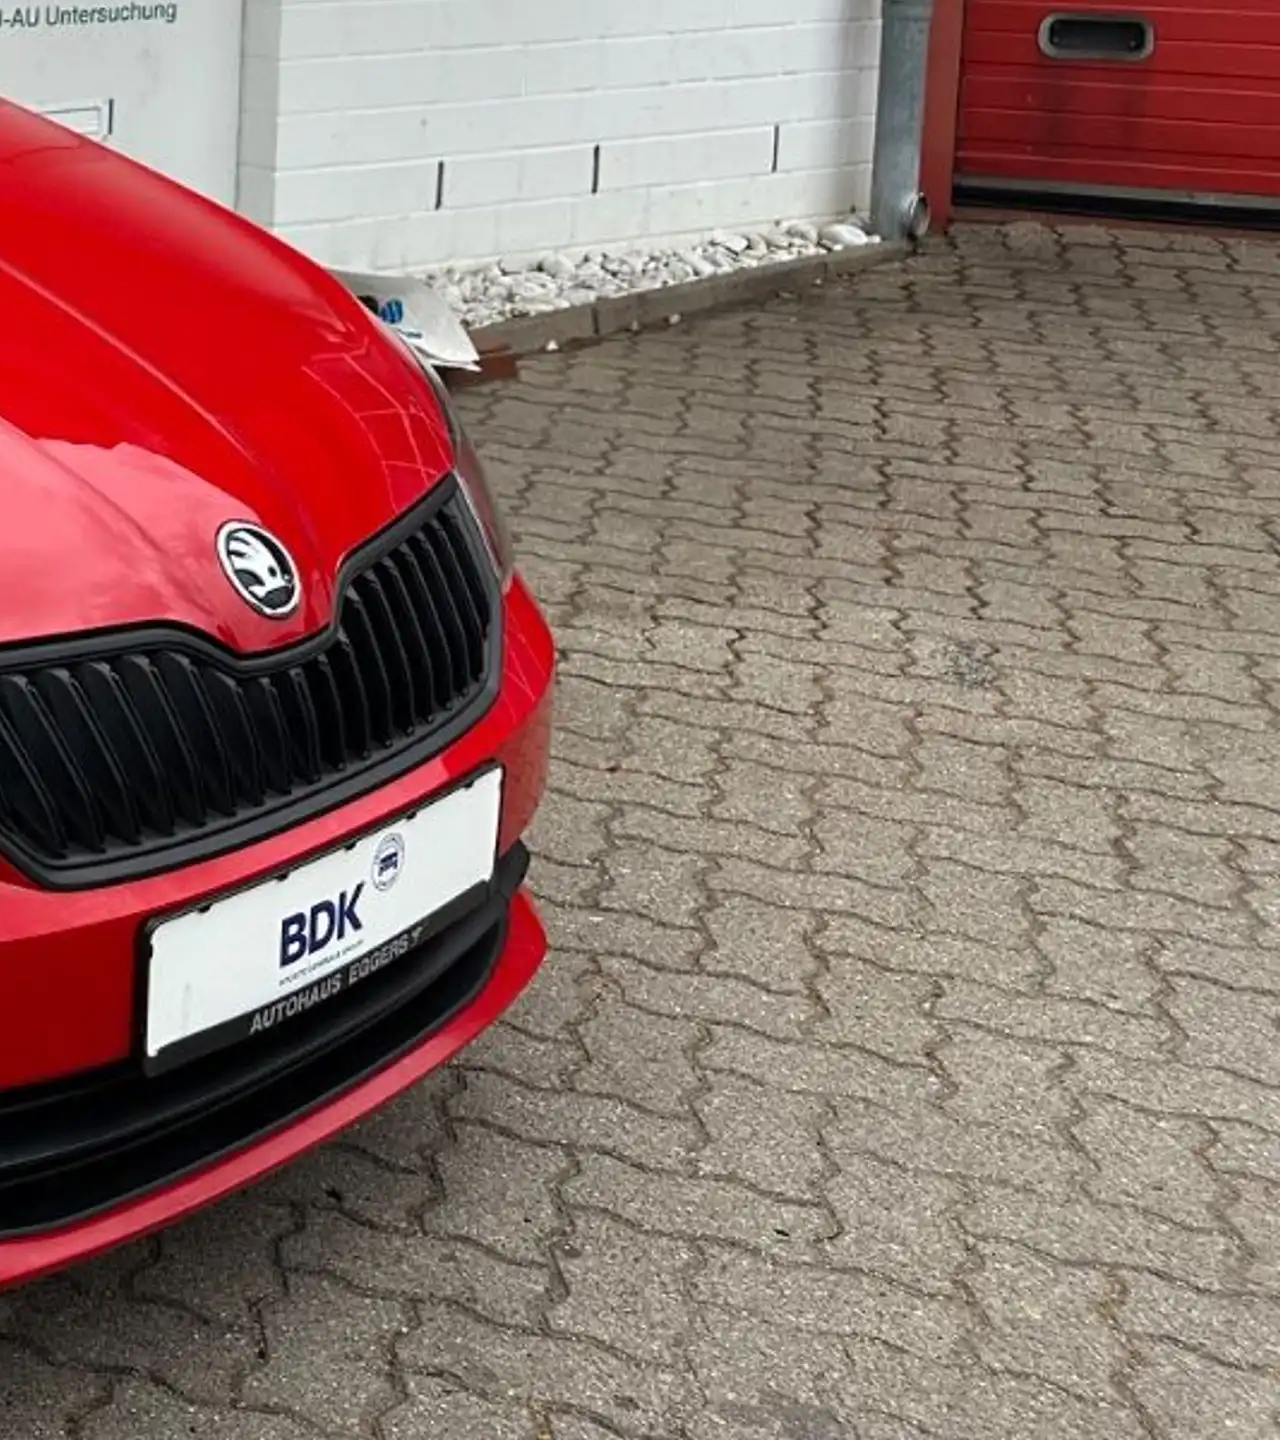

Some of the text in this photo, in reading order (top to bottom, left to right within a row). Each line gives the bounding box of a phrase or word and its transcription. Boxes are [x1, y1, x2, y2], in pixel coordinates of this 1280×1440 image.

[45, 1, 178, 27] Untersuchung
[280, 881, 365, 967] BDK
[249, 973, 341, 1034] AUTOHAUS
[348, 935, 411, 984] EGGERS
